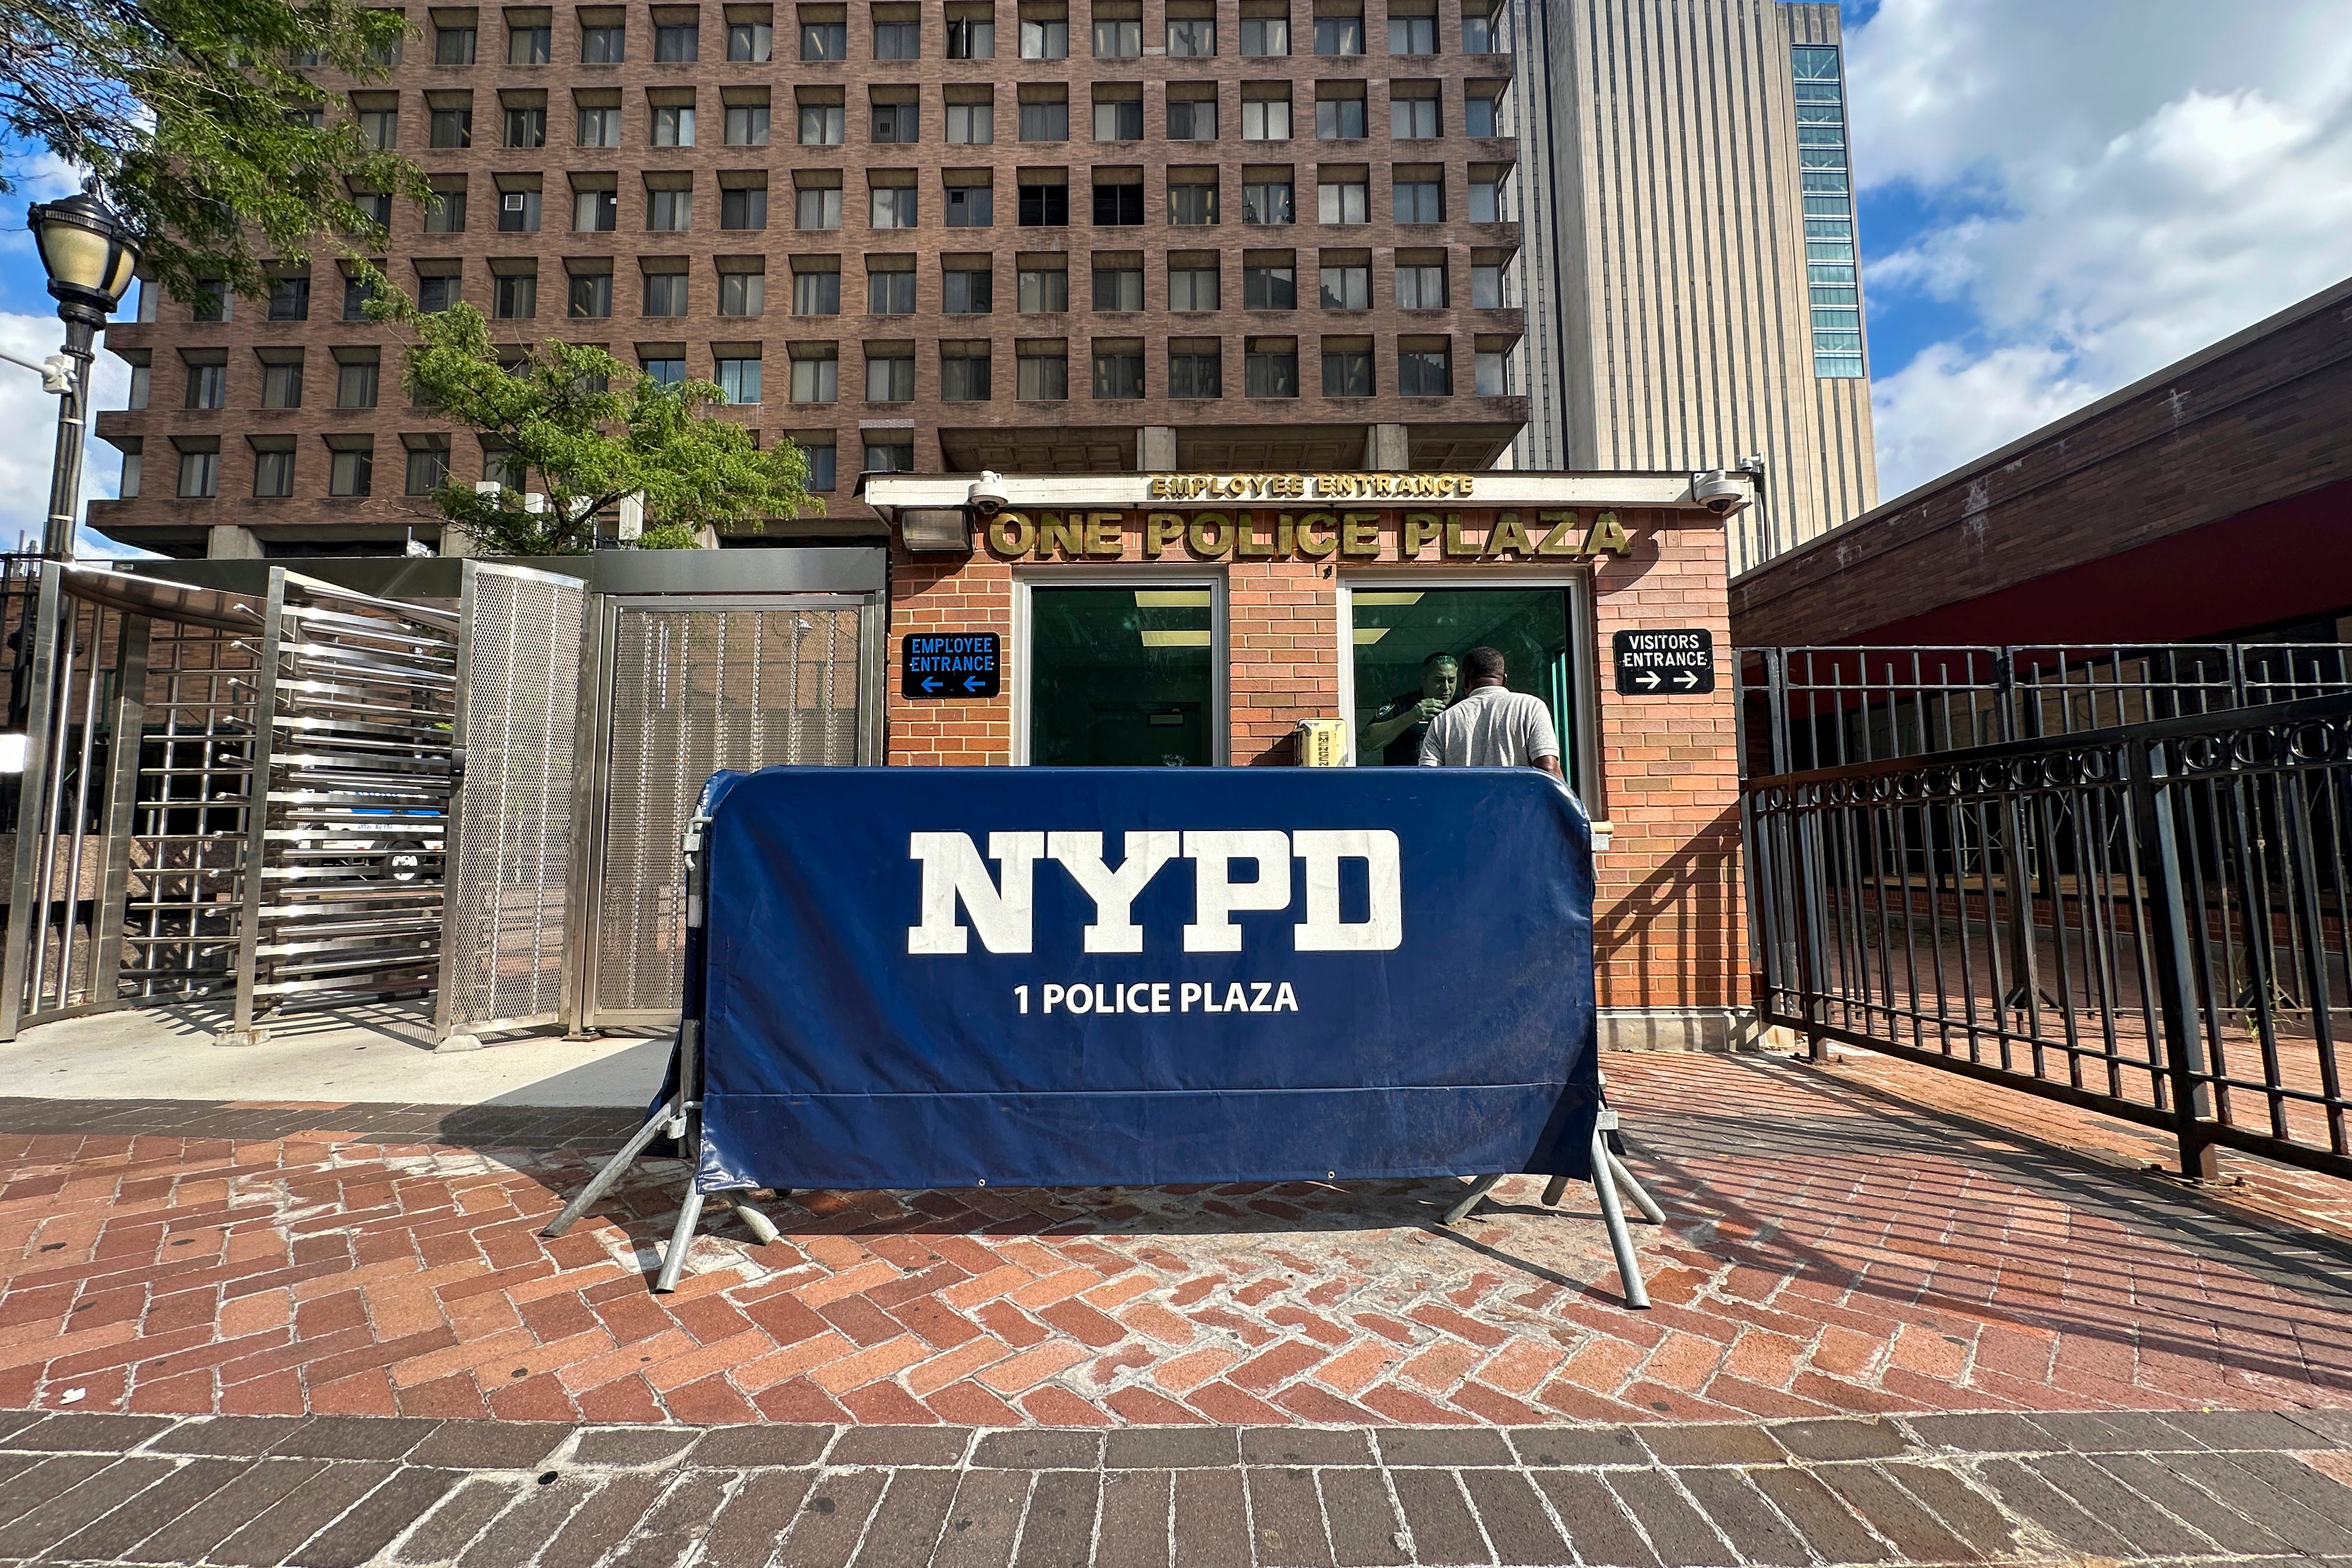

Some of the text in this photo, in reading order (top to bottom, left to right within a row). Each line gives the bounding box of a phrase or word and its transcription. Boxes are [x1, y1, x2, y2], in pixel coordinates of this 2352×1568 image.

[1152, 474, 1474, 495] EMPLOYEE ENTRANCE
[990, 511, 1633, 556] ONE POLICE PLAZA
[912, 637, 992, 653] EMPLOYEE
[1628, 634, 1700, 650] VISITORS
[911, 656, 993, 672] ENTRANCE
[1623, 651, 1707, 667] ENTRANCE
[1318, 730, 1329, 766] EMERGEN
[908, 829, 1403, 954] NYPD
[1014, 981, 1299, 1014] 1 POLICE PLAZA
